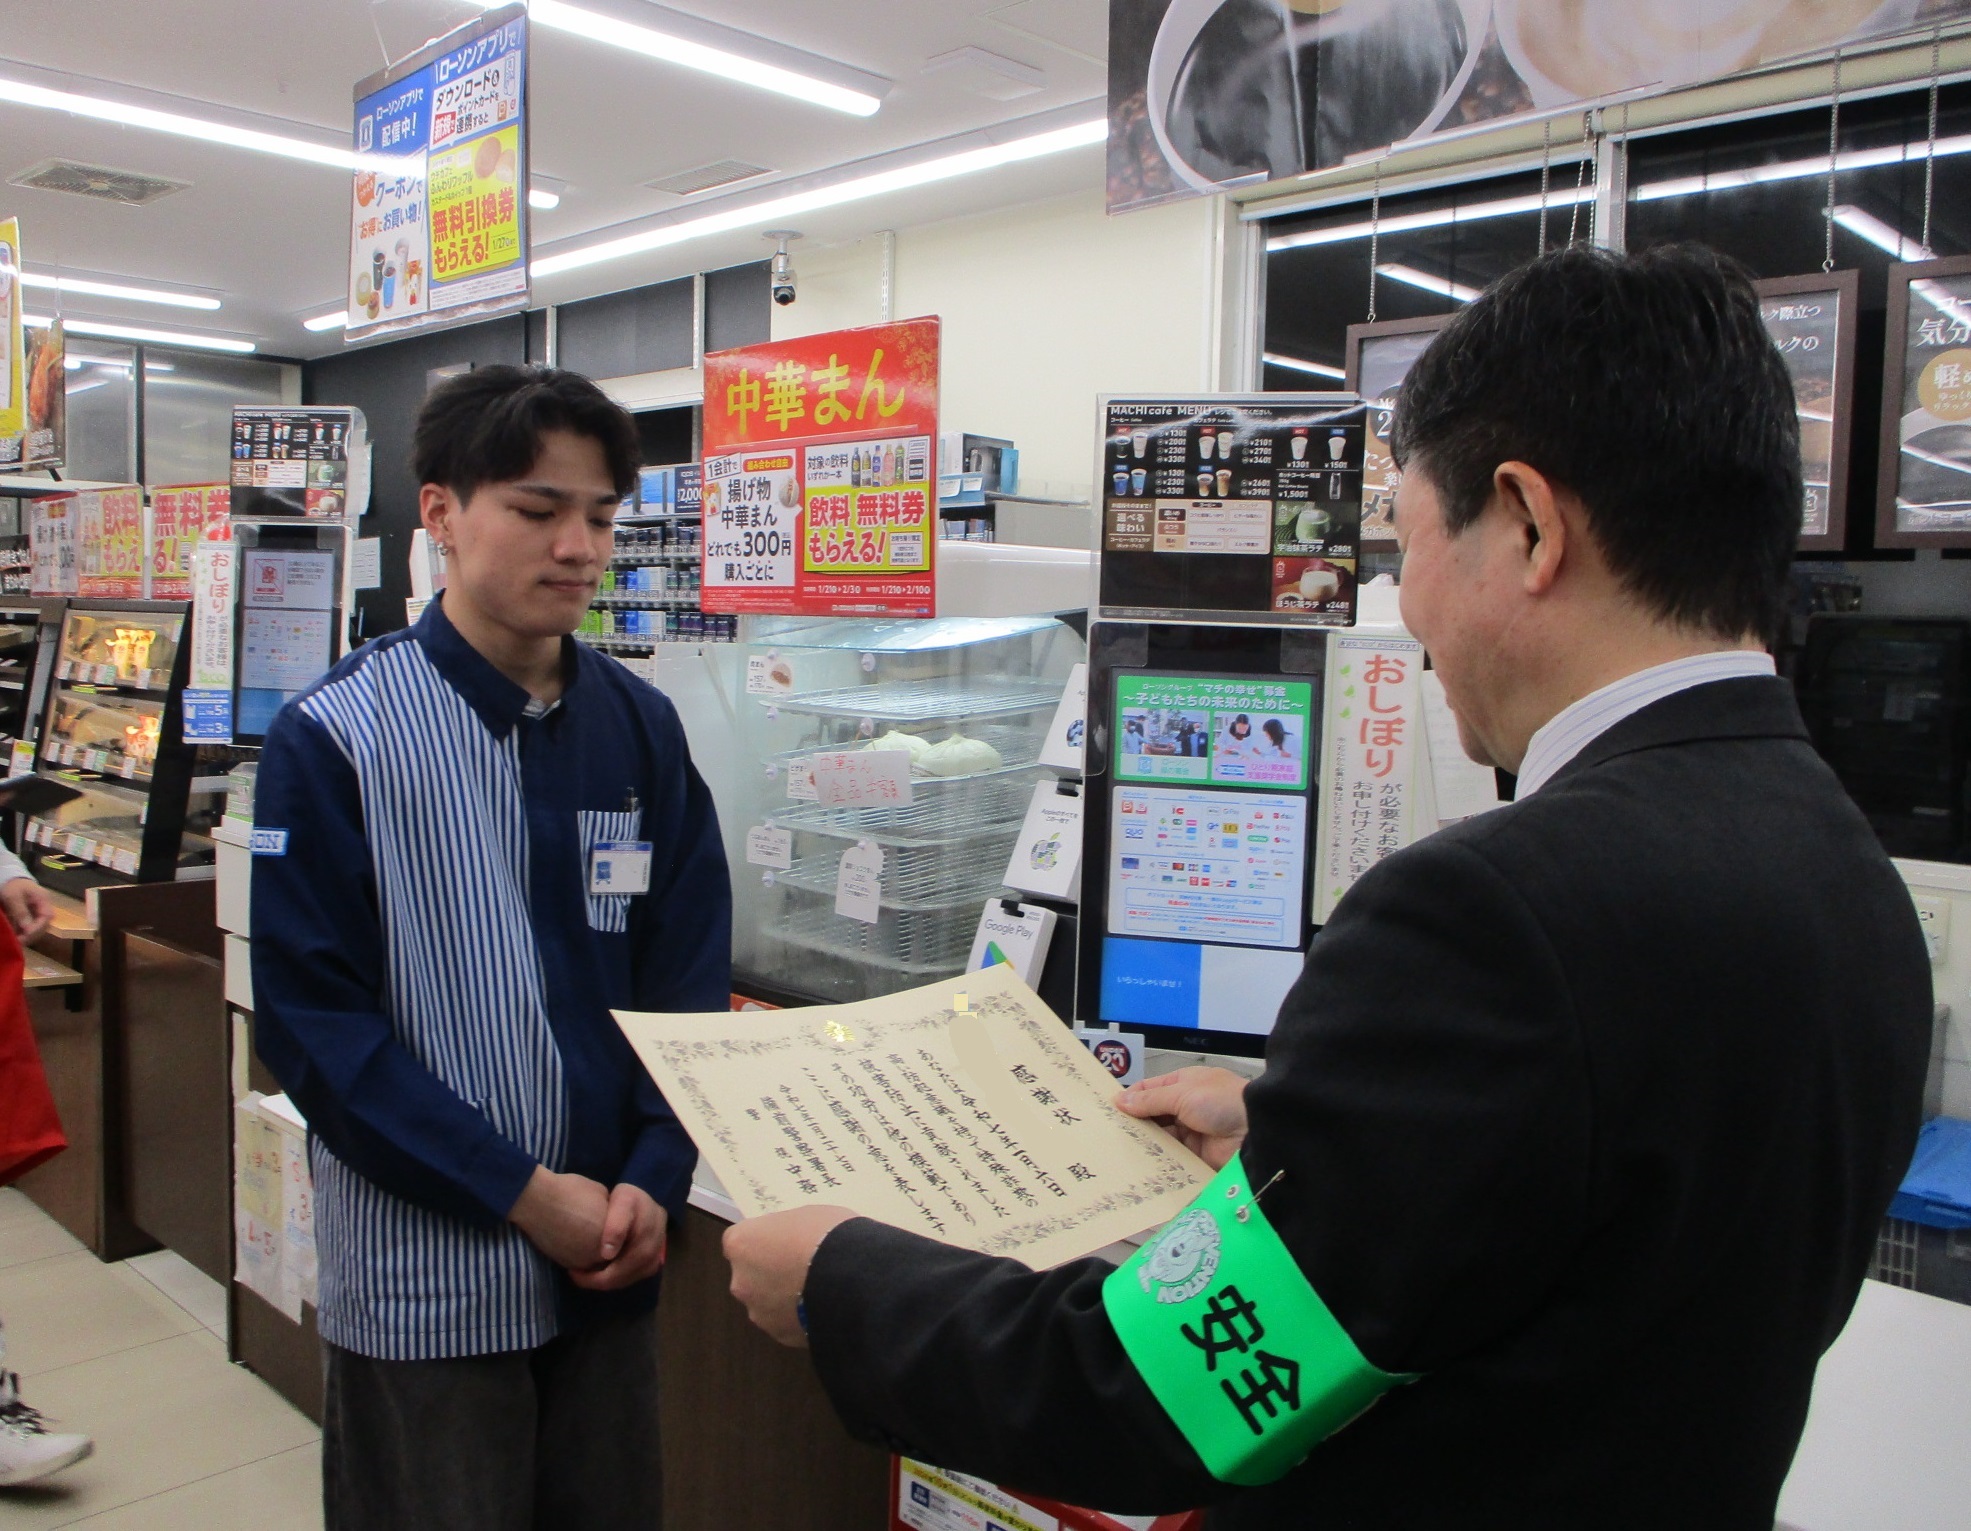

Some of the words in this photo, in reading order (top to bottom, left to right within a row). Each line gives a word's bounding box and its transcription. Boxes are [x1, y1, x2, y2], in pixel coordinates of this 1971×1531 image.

[432, 186, 515, 243] 無料引換券
[727, 348, 905, 436] 中華まん
[1110, 405, 1147, 416] MACHI
[728, 476, 772, 503] 揚げ物
[807, 453, 848, 469] 対象の飲料
[721, 504, 778, 530] 中華まん
[809, 494, 851, 528] 飲料
[857, 490, 926, 527] 無料券
[1116, 513, 1145, 523] 選べる
[1116, 523, 1145, 533] 味わい
[724, 562, 774, 582] 購入ごとに
[808, 531, 887, 564] もらえる!
[209, 551, 230, 614] おしぼり
[1359, 654, 1407, 778] おしぼり
[984, 918, 1014, 936] Google
[1015, 921, 1034, 940] Play
[917, 1049, 1068, 1198] あなたは令和七年一月六日
[1009, 1064, 1082, 1126] 感謝状
[760, 1096, 842, 1188] 備前警察署長
[779, 1084, 856, 1173] 令和七年一月二十七日
[801, 1067, 945, 1236] ここに感謝の意を表します
[831, 1062, 976, 1226] その功労は他の模範であり
[858, 1059, 1011, 1218] 被害防止に貢献されました
[886, 1053, 1039, 1208] 高い防犯意識を持って特殊詐欺の
[1180, 1284, 1300, 1435] 安全
